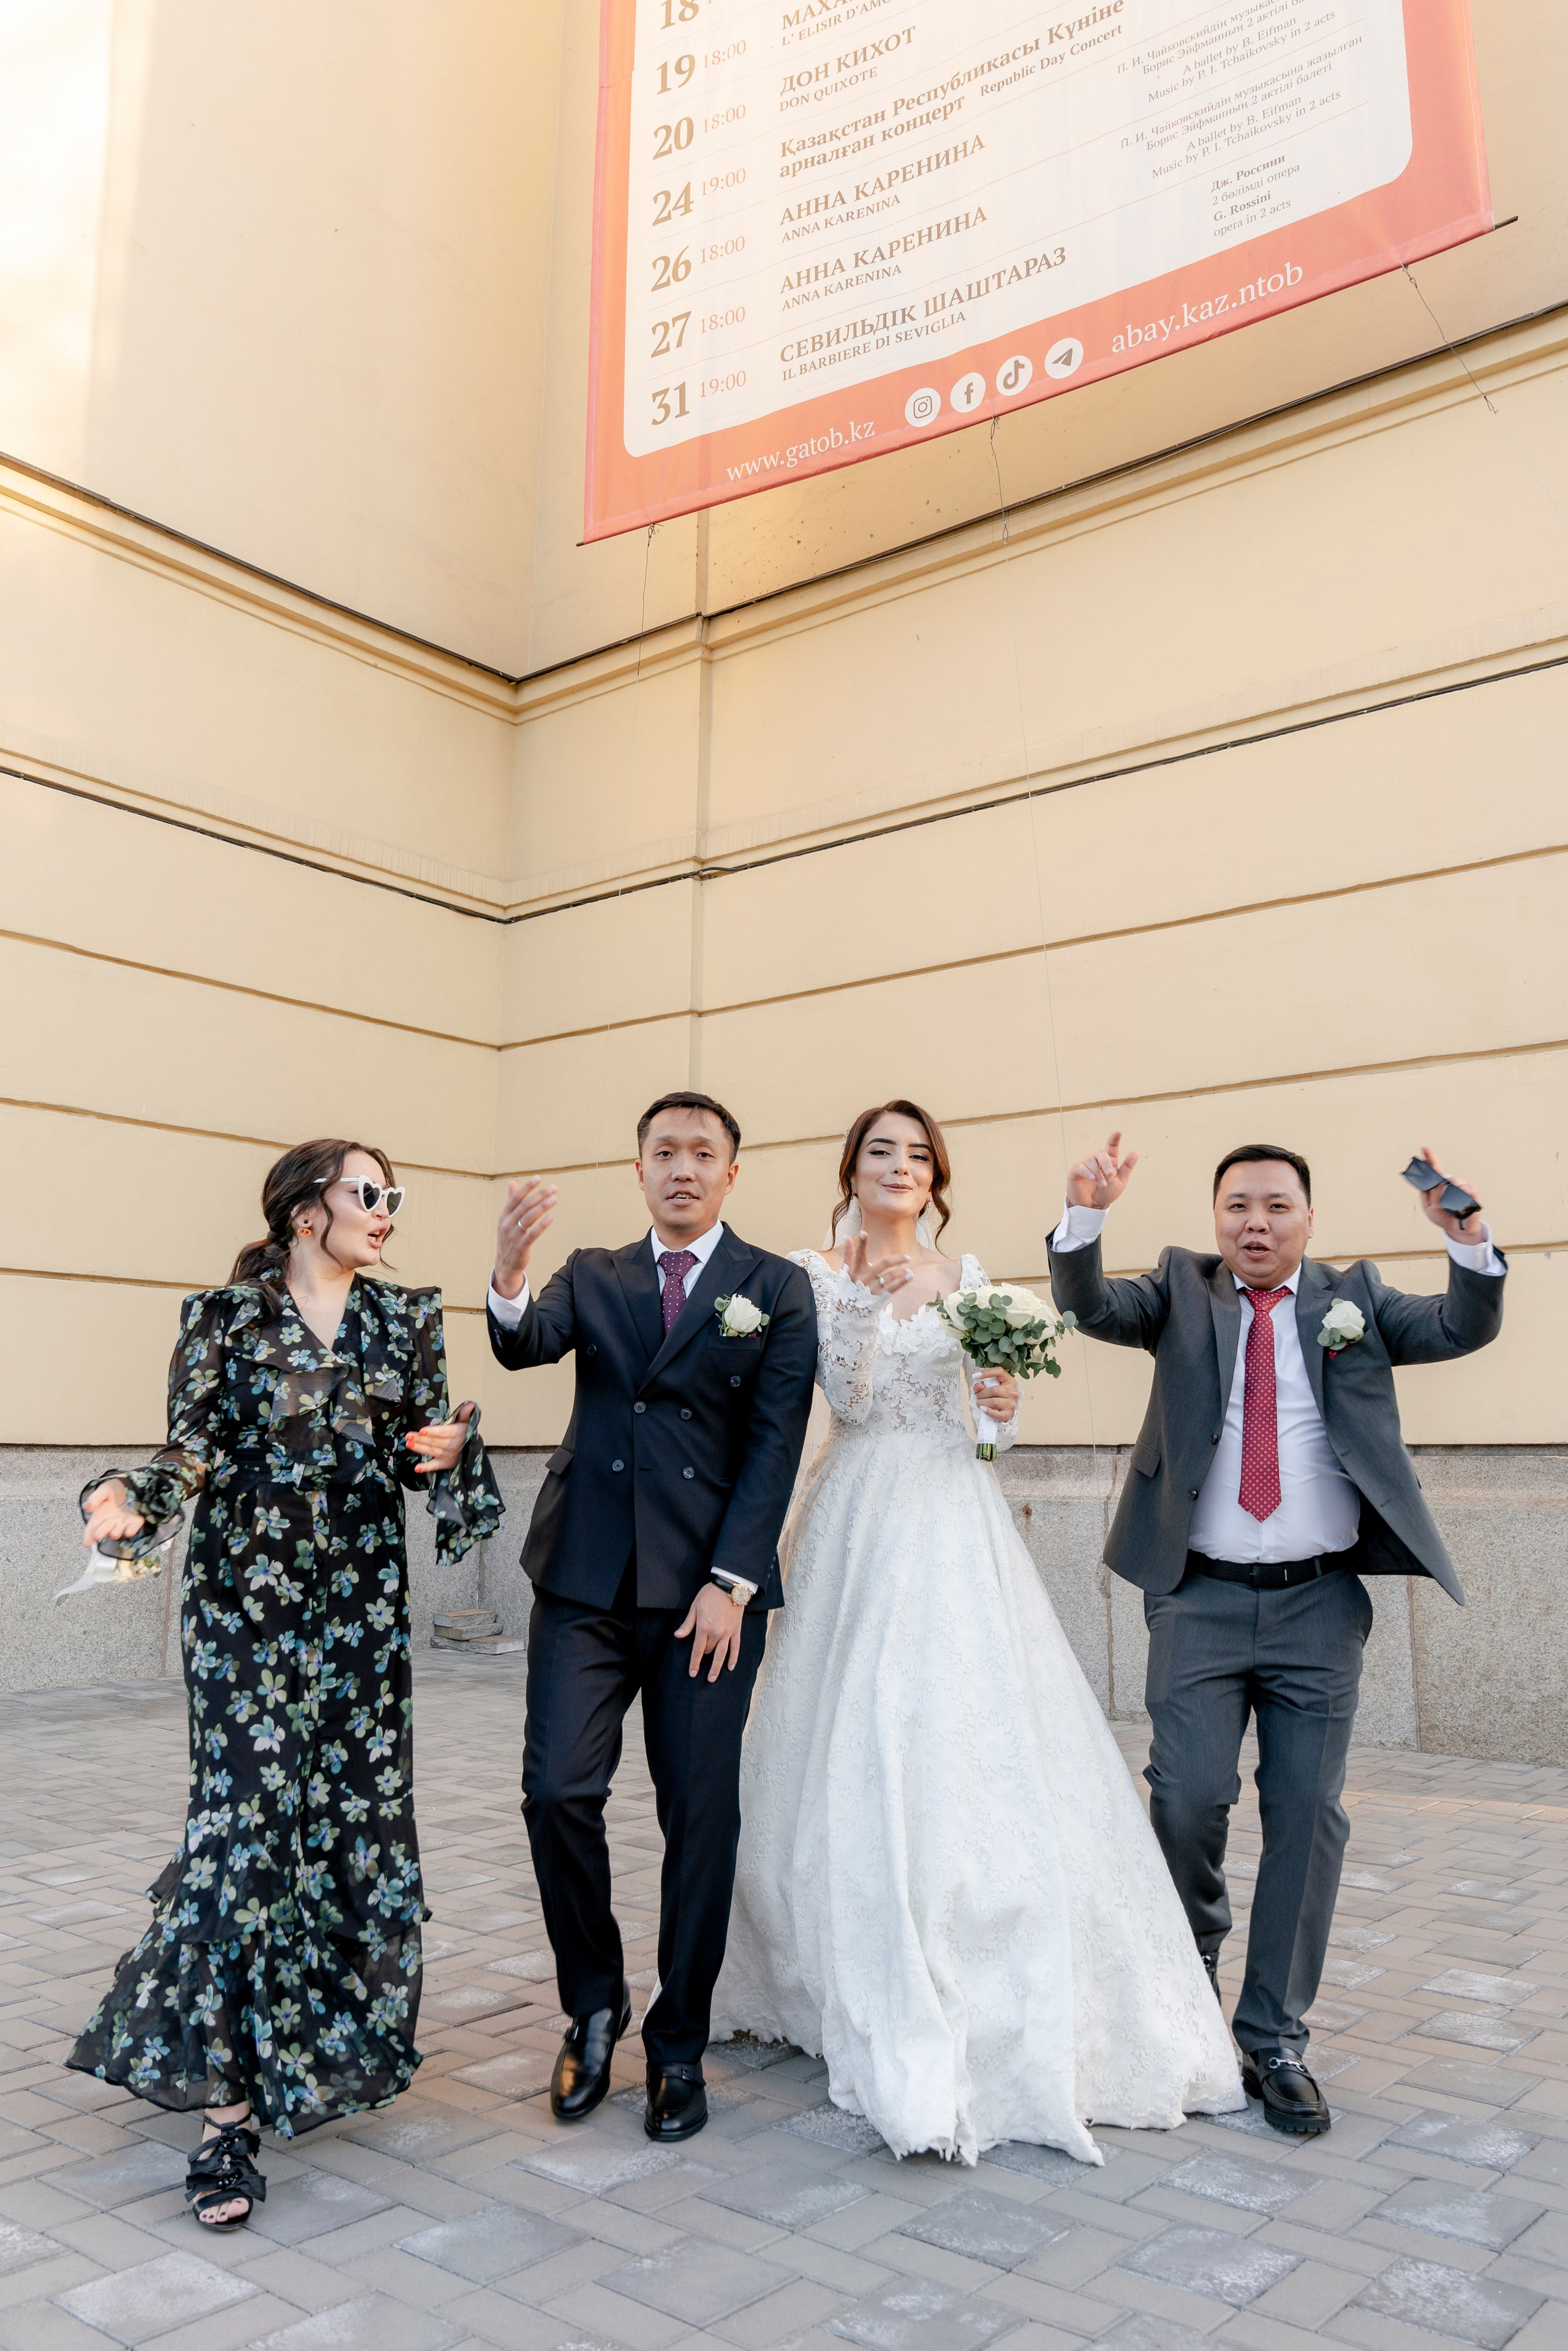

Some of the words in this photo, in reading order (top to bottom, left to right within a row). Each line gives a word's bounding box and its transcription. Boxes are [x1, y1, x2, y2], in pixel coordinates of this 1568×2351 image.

[661, 0, 699, 30] 18
[799, 14, 842, 41] ELISIR
[1143, 56, 1174, 75] Борис
[1178, 24, 1244, 59] Эйфманның
[1247, 18, 1253, 28] 2
[1257, 1, 1287, 23] актілі
[657, 55, 695, 96] 19
[703, 40, 746, 69] 18:00
[780, 62, 830, 96] ДОН
[836, 25, 916, 74] КИХОТ
[980, 65, 1036, 97] Republic
[1040, 53, 1065, 70] Day
[1070, 25, 1122, 56] Concert
[1117, 63, 1128, 74] П.
[1132, 56, 1144, 67] И.
[1148, 20, 1227, 60] Чайковскийдің
[1148, 83, 1179, 102] Music
[1182, 76, 1194, 87] by
[1198, 70, 1206, 80] P.
[1210, 66, 1217, 74] I.
[1220, 34, 1287, 69] Tchaikovsky
[1291, 28, 1300, 39] in
[1304, 21, 1311, 31] 2
[1314, 11, 1335, 26] acts
[1183, 64, 1191, 75] A
[1194, 51, 1223, 70] ballet
[1226, 44, 1238, 55] by
[1242, 37, 1254, 48] B.
[1257, 18, 1296, 42] Eifman
[780, 110, 886, 158] Қазақстан
[892, 38, 1041, 117] Республикасы
[1047, 0, 1124, 45] Күніне
[780, 94, 810, 111] DON
[814, 67, 877, 101] QUIXOTE
[1121, 138, 1132, 149] П.
[1136, 132, 1147, 142] И.
[1152, 97, 1231, 136] Чайковскийдің
[1234, 64, 1303, 100] музыкасына
[1307, 36, 1362, 68] жазылған
[1147, 131, 1178, 151] Борис
[1182, 102, 1248, 135] Эйфманның
[1251, 96, 1257, 105] 2
[1261, 79, 1292, 100] актілі
[1297, 62, 1332, 85] балеті
[653, 116, 694, 160] 20
[703, 104, 746, 134] 18:00
[780, 134, 875, 178] арналған
[880, 96, 965, 144] концерт
[1152, 160, 1183, 178] Music
[1186, 153, 1198, 164] by
[1202, 146, 1210, 157] P.
[1215, 143, 1221, 151] I.
[1224, 114, 1292, 146] Tchaikovsky
[1295, 107, 1305, 117] in
[1309, 100, 1316, 110] 2
[1319, 91, 1341, 106] acts
[1186, 142, 1195, 151] A
[1198, 128, 1227, 146] ballet
[1230, 122, 1243, 133] by
[1247, 115, 1258, 126] B.
[1262, 97, 1301, 119] Eifman
[652, 181, 694, 227] 24
[701, 168, 745, 197] 19:00
[779, 191, 847, 225] АННА
[854, 134, 986, 202] КАРЕНИНА
[1211, 178, 1232, 193] Дж.
[1236, 155, 1286, 181] Россини
[1212, 196, 1218, 206] 2
[1221, 177, 1264, 202] бөлімді
[1267, 165, 1300, 183] опера
[782, 222, 821, 243] ANNA
[824, 194, 900, 229] KARENINA
[1214, 211, 1226, 221] G.
[1231, 191, 1271, 215] Rossini
[1214, 221, 1243, 236] opera
[1246, 214, 1256, 224] in
[1260, 208, 1266, 218] 2
[1270, 200, 1291, 214] acts
[651, 246, 692, 292] 26
[701, 236, 745, 263] 18:00
[780, 258, 847, 295] АННА
[853, 206, 987, 269] КАРЕНИНА
[780, 304, 917, 363] СЕВИЛЬДІК
[924, 246, 1066, 318] ШАШТАРАЗ
[782, 290, 821, 311] ANNA
[824, 264, 902, 297] KARENINA
[1112, 262, 1303, 353] abay.kaz.ntob
[651, 311, 692, 358] 27
[700, 306, 745, 334] 18:00
[782, 367, 796, 381] IL
[799, 341, 871, 375] BARBIERE
[876, 334, 891, 349] DI
[895, 311, 966, 344] SEVIGLIA
[652, 381, 690, 426] 31
[700, 371, 746, 398] 19:00
[726, 419, 876, 482] www.gatob.kz
